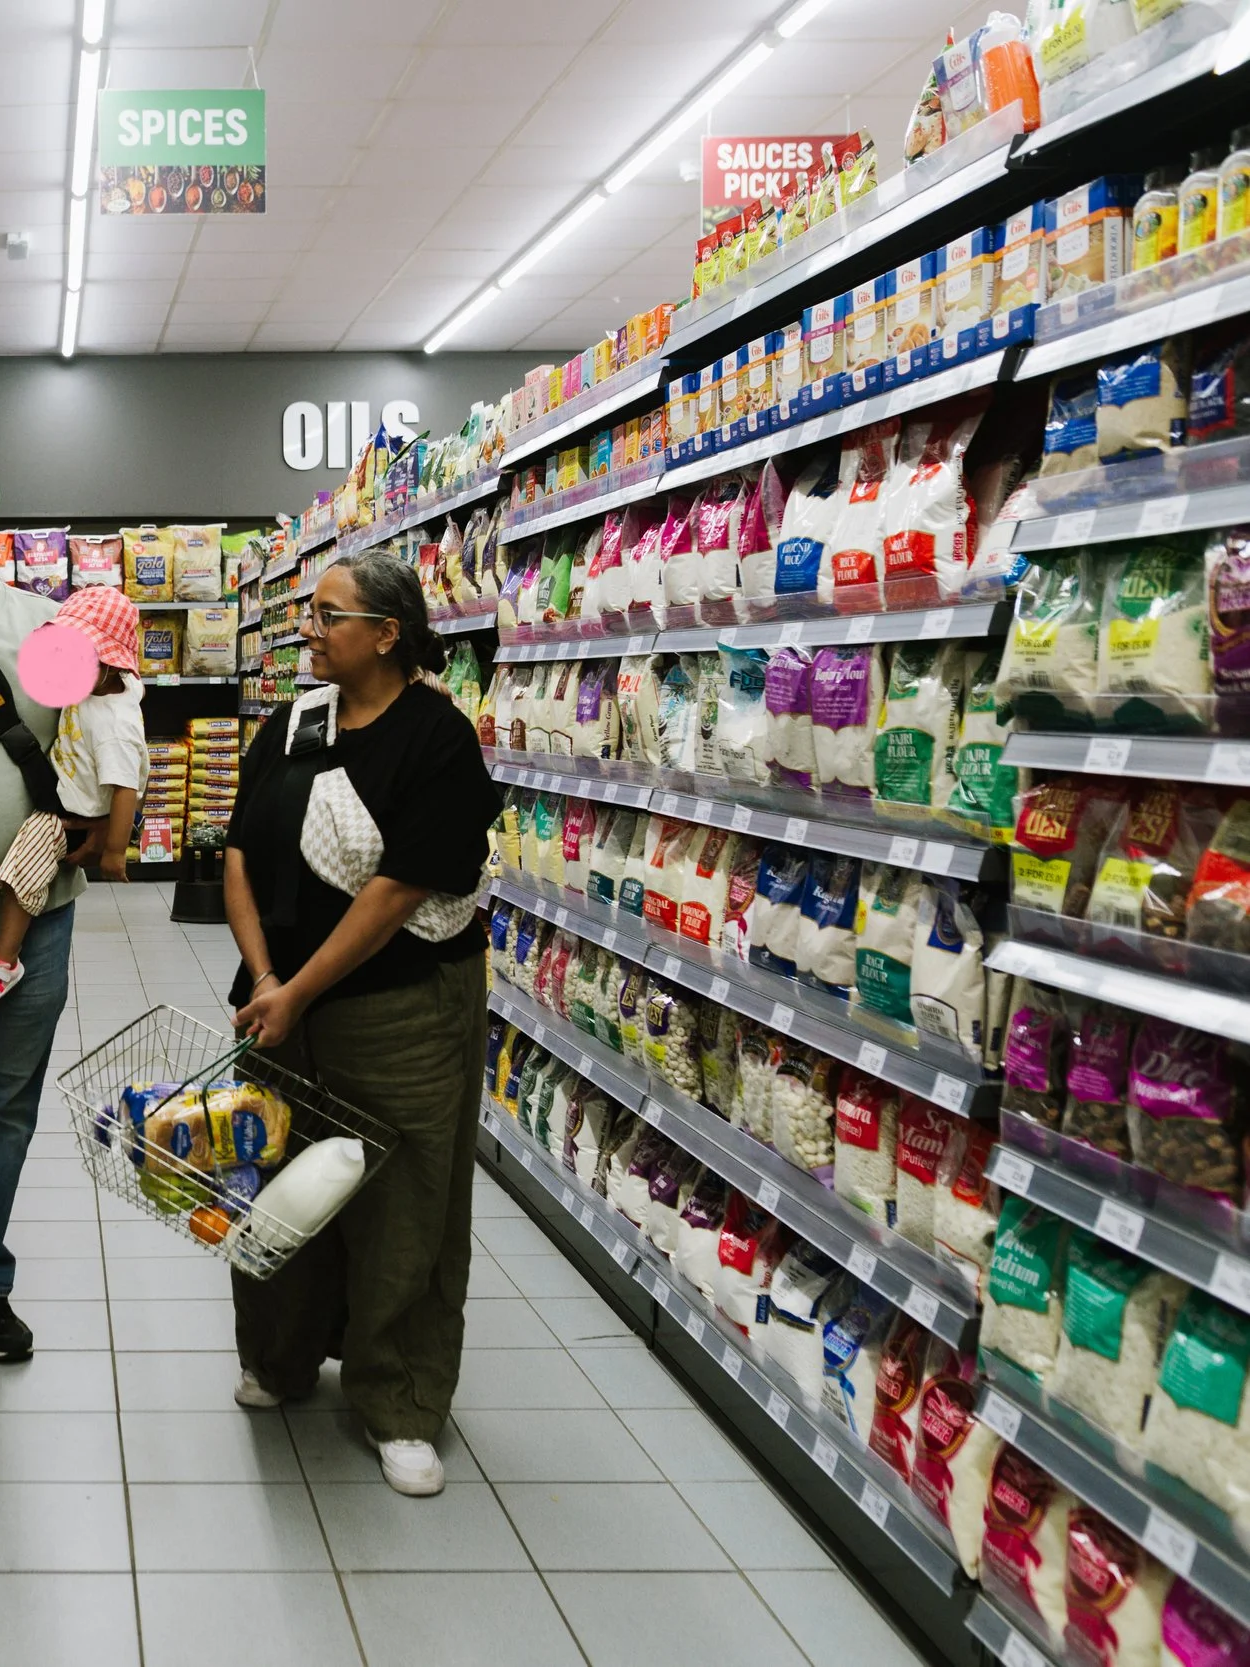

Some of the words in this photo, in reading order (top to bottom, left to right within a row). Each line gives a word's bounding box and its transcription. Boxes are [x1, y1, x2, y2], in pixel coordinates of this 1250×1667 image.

[118, 108, 248, 146] SPICES
[717, 141, 813, 170] SAUCES
[724, 172, 809, 199] PICK
[951, 246, 967, 262] Gits
[901, 268, 917, 285] Gits
[283, 400, 420, 471] OILS
[889, 538, 909, 551] RICE
[784, 554, 801, 565] RICE
[840, 556, 857, 568] RICE
[889, 550, 915, 565] FLOUR
[137, 556, 165, 576] gold
[837, 568, 859, 582] FLOUR
[865, 953, 884, 968] RAGI
[862, 965, 888, 983] FLOUR
